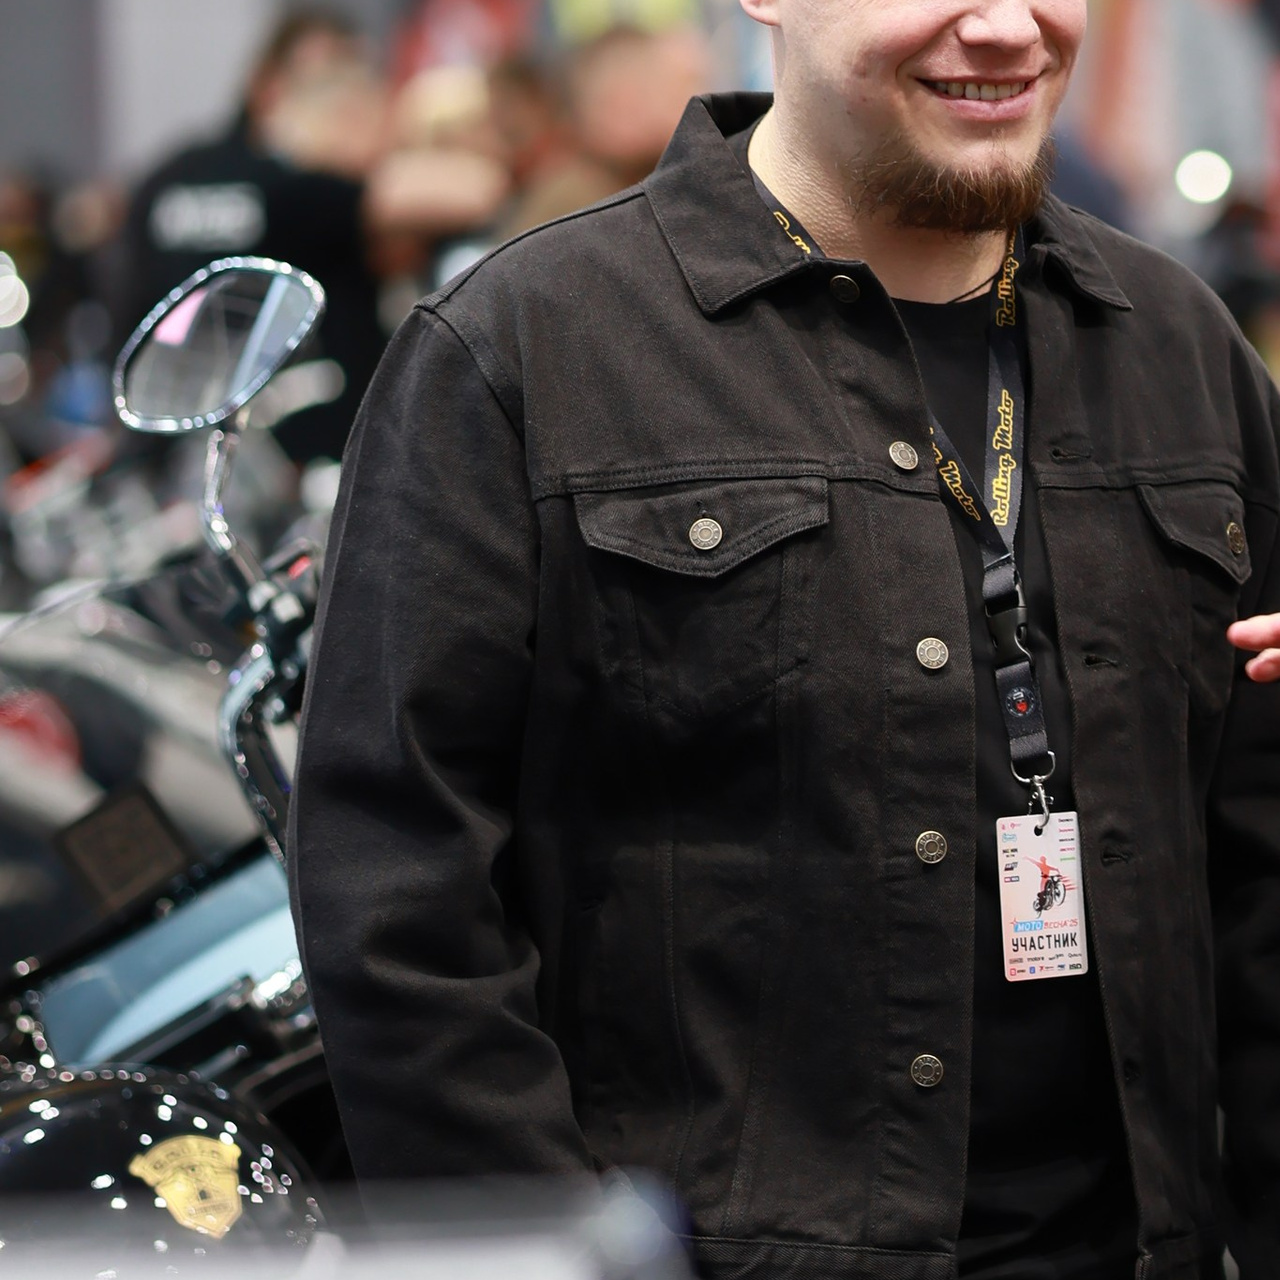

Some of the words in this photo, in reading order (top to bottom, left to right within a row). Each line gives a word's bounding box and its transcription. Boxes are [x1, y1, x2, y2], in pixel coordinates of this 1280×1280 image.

[993, 388, 1014, 450] Moto
[939, 460, 982, 521] Moto
[990, 453, 1017, 527] Rolling
[1011, 932, 1078, 953] УЧАСТНИК
